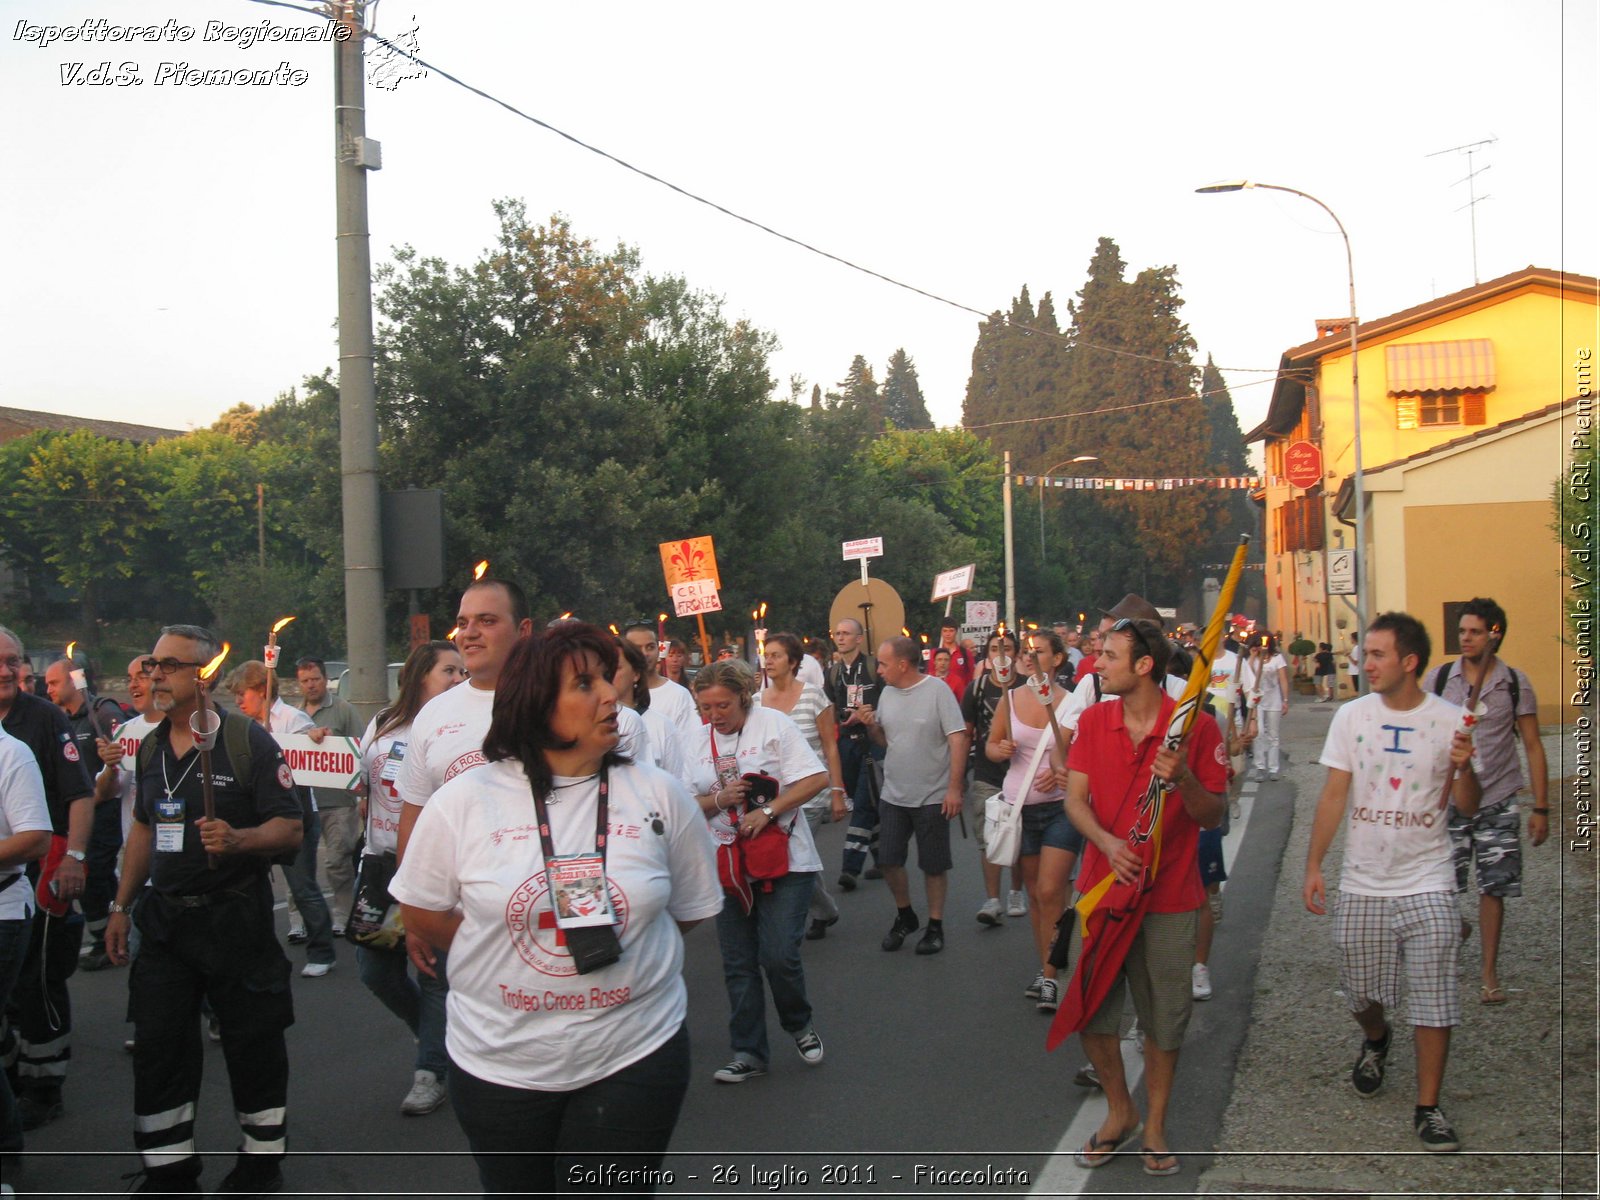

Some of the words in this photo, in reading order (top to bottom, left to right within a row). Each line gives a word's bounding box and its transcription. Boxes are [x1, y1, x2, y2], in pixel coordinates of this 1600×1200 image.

[678, 585, 702, 597] CRI
[1381, 724, 1415, 754] I
[283, 749, 354, 774] MONTECELIO
[511, 883, 537, 932] CROCE
[499, 984, 540, 1012] Trofeo
[543, 991, 585, 1011] Croce
[589, 987, 630, 1008] Rossa
